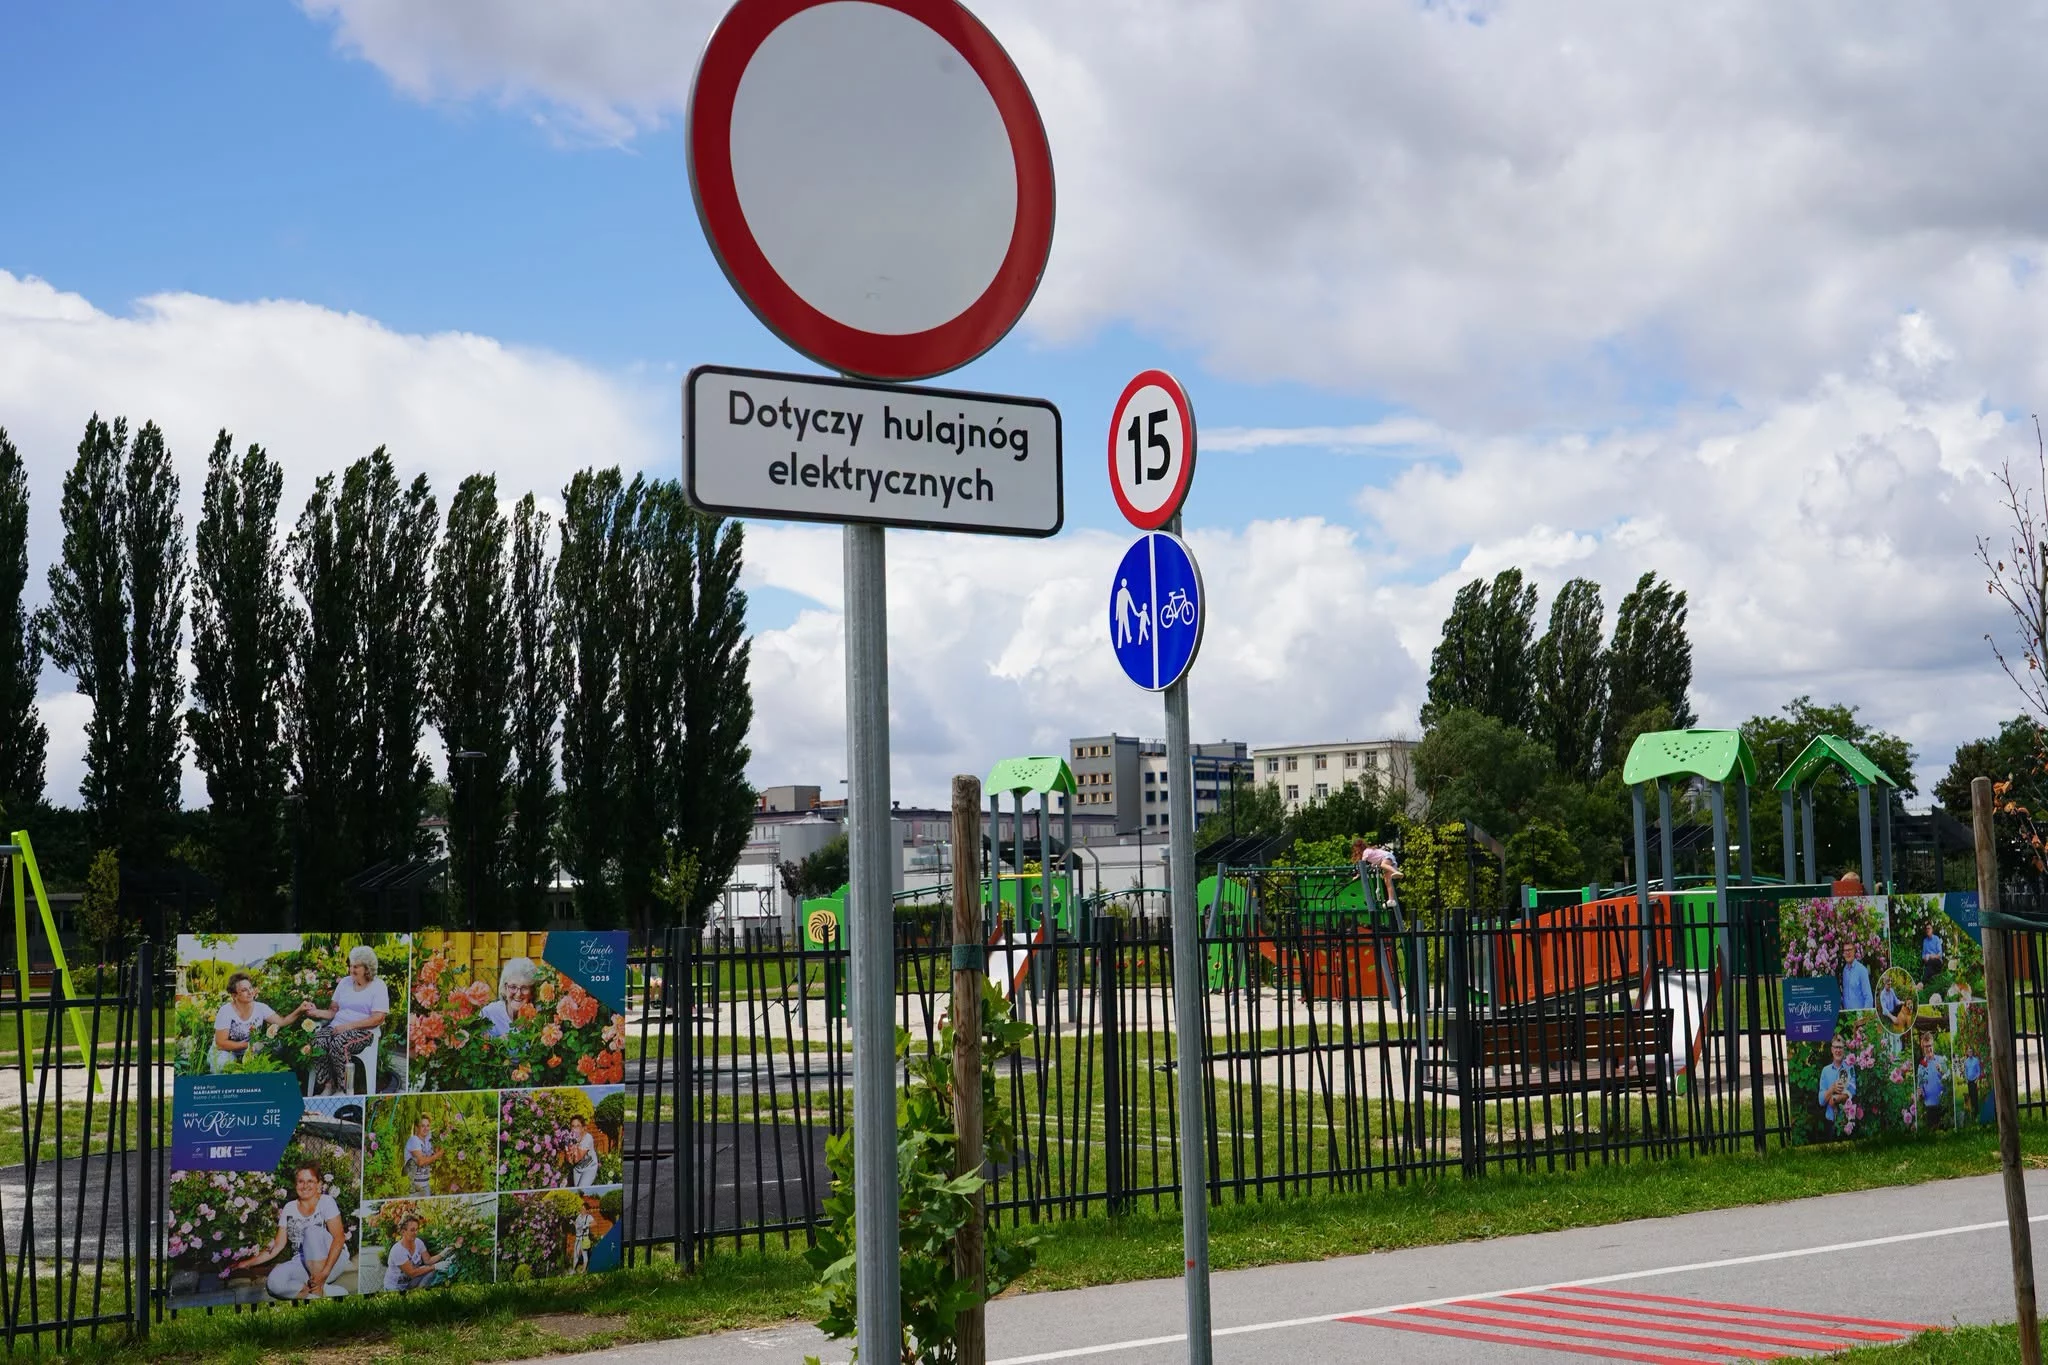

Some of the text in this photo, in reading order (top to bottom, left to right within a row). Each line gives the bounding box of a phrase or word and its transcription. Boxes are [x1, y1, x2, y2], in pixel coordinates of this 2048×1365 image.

[729, 390, 1029, 462] Dotyczy hulajnóg
[1127, 408, 1171, 485] 15
[768, 451, 994, 509] elektrycznych
[262, 1114, 281, 1127] SIĘ
